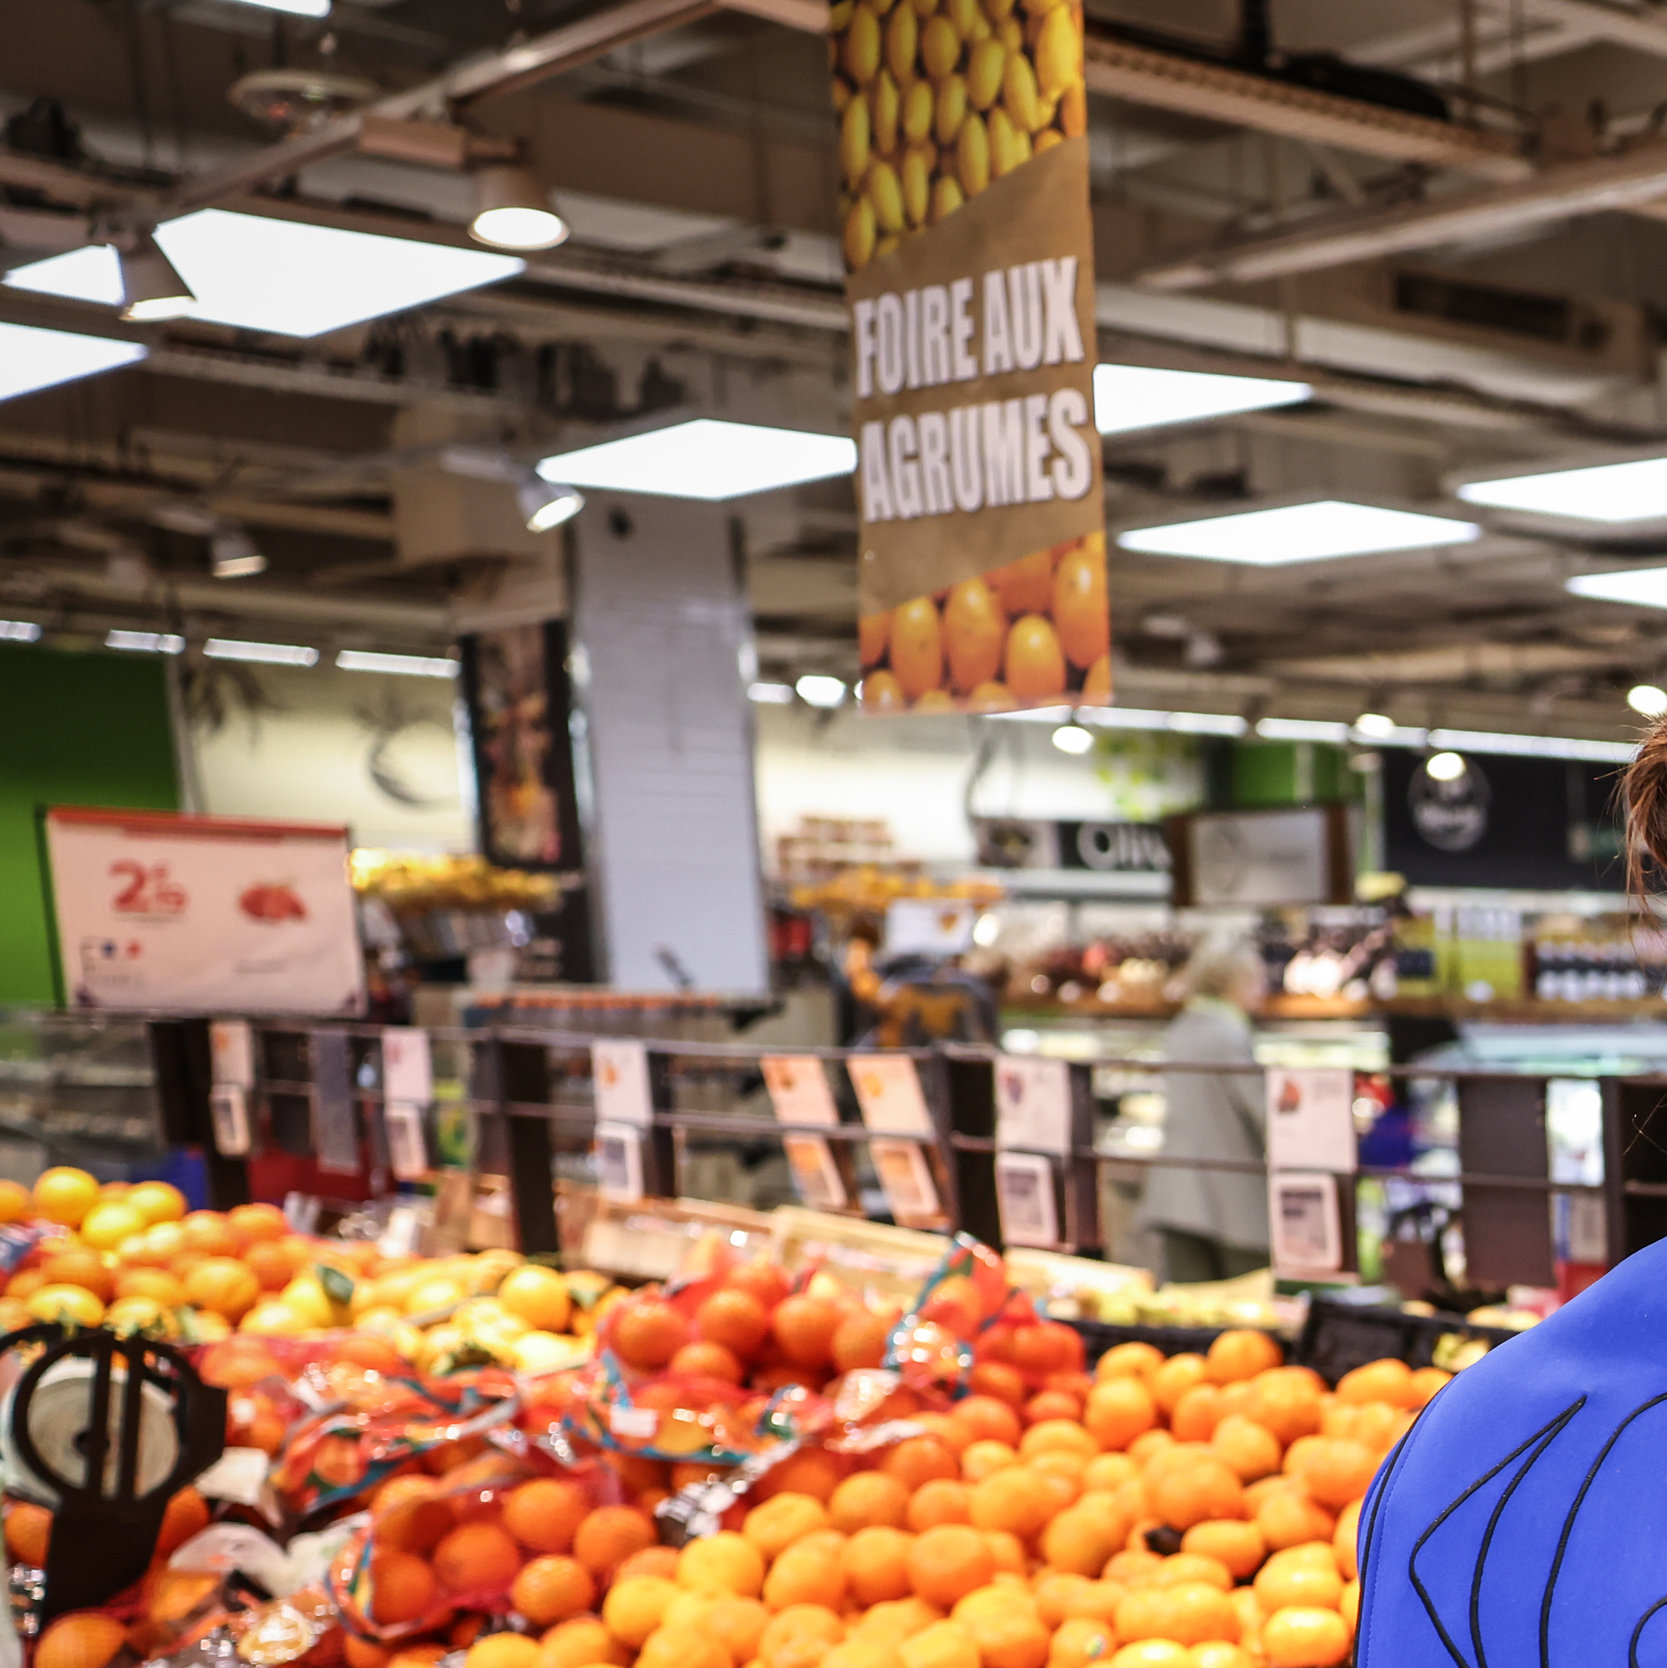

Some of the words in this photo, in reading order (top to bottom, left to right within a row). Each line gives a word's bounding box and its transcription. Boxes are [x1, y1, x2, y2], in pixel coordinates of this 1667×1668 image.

[854, 276, 978, 398] FOIRE
[982, 254, 1085, 376] AUX
[860, 386, 1093, 523] AGRUMES
